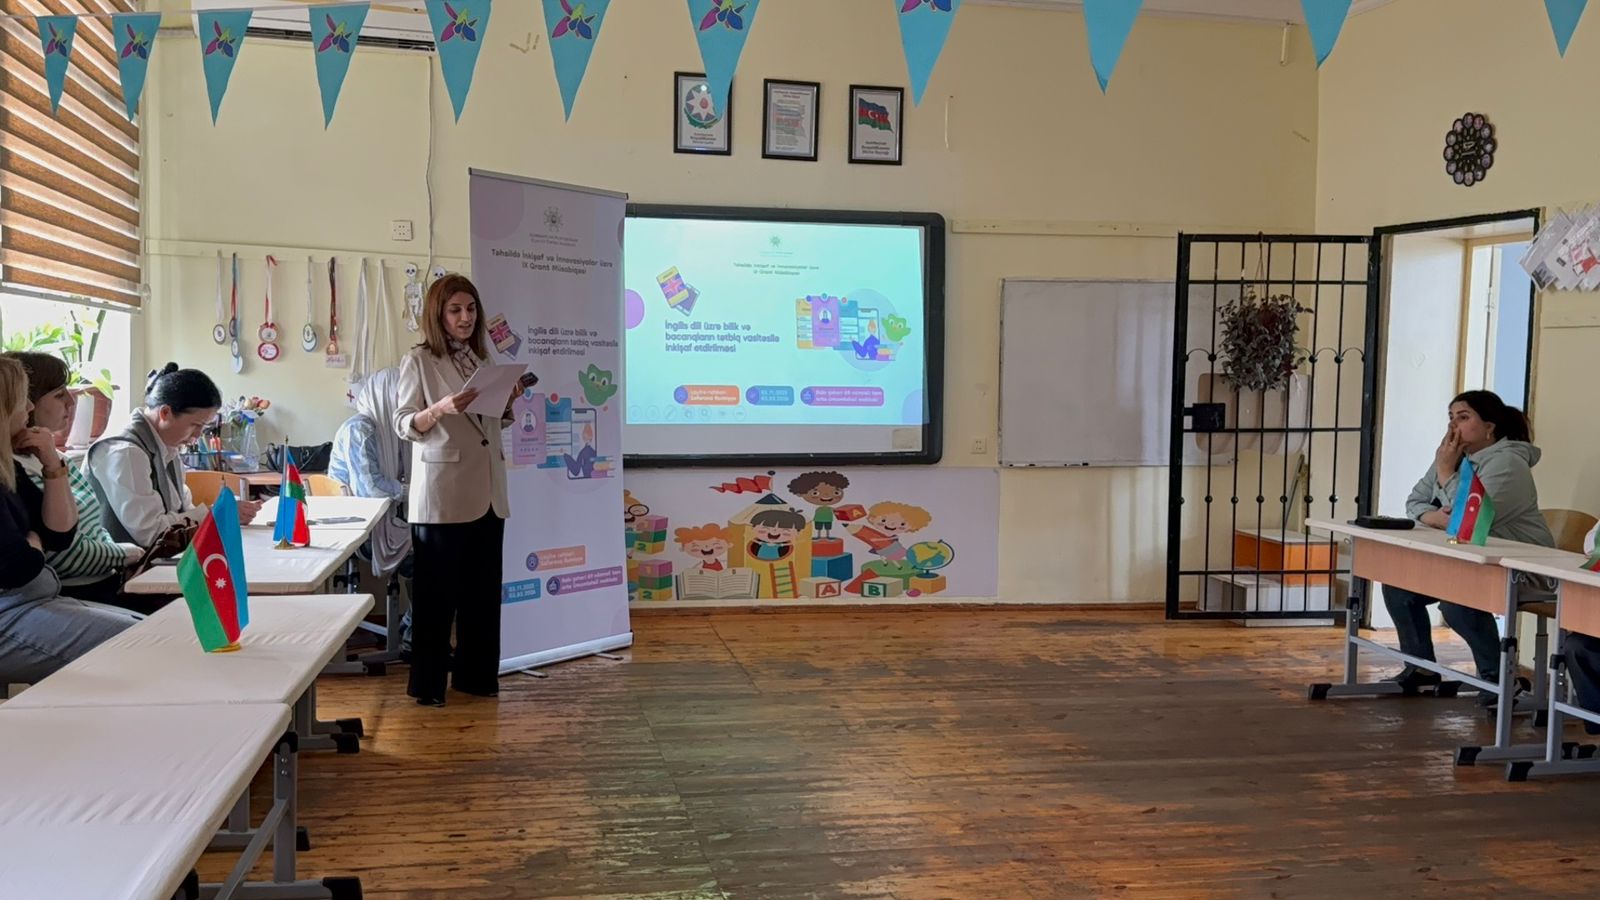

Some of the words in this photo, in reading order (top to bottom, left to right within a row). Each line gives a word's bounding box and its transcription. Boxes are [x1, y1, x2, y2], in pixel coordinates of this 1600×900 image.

[665, 319, 688, 332] İngilis
[690, 321, 702, 330] dili
[704, 322, 722, 330] üzrə
[723, 322, 739, 331] bilik
[548, 327, 559, 335] dili
[852, 509, 862, 518] A
[637, 543, 646, 552] 2
[642, 590, 653, 599] 2
[821, 584, 836, 596] A
[868, 585, 880, 596] B
